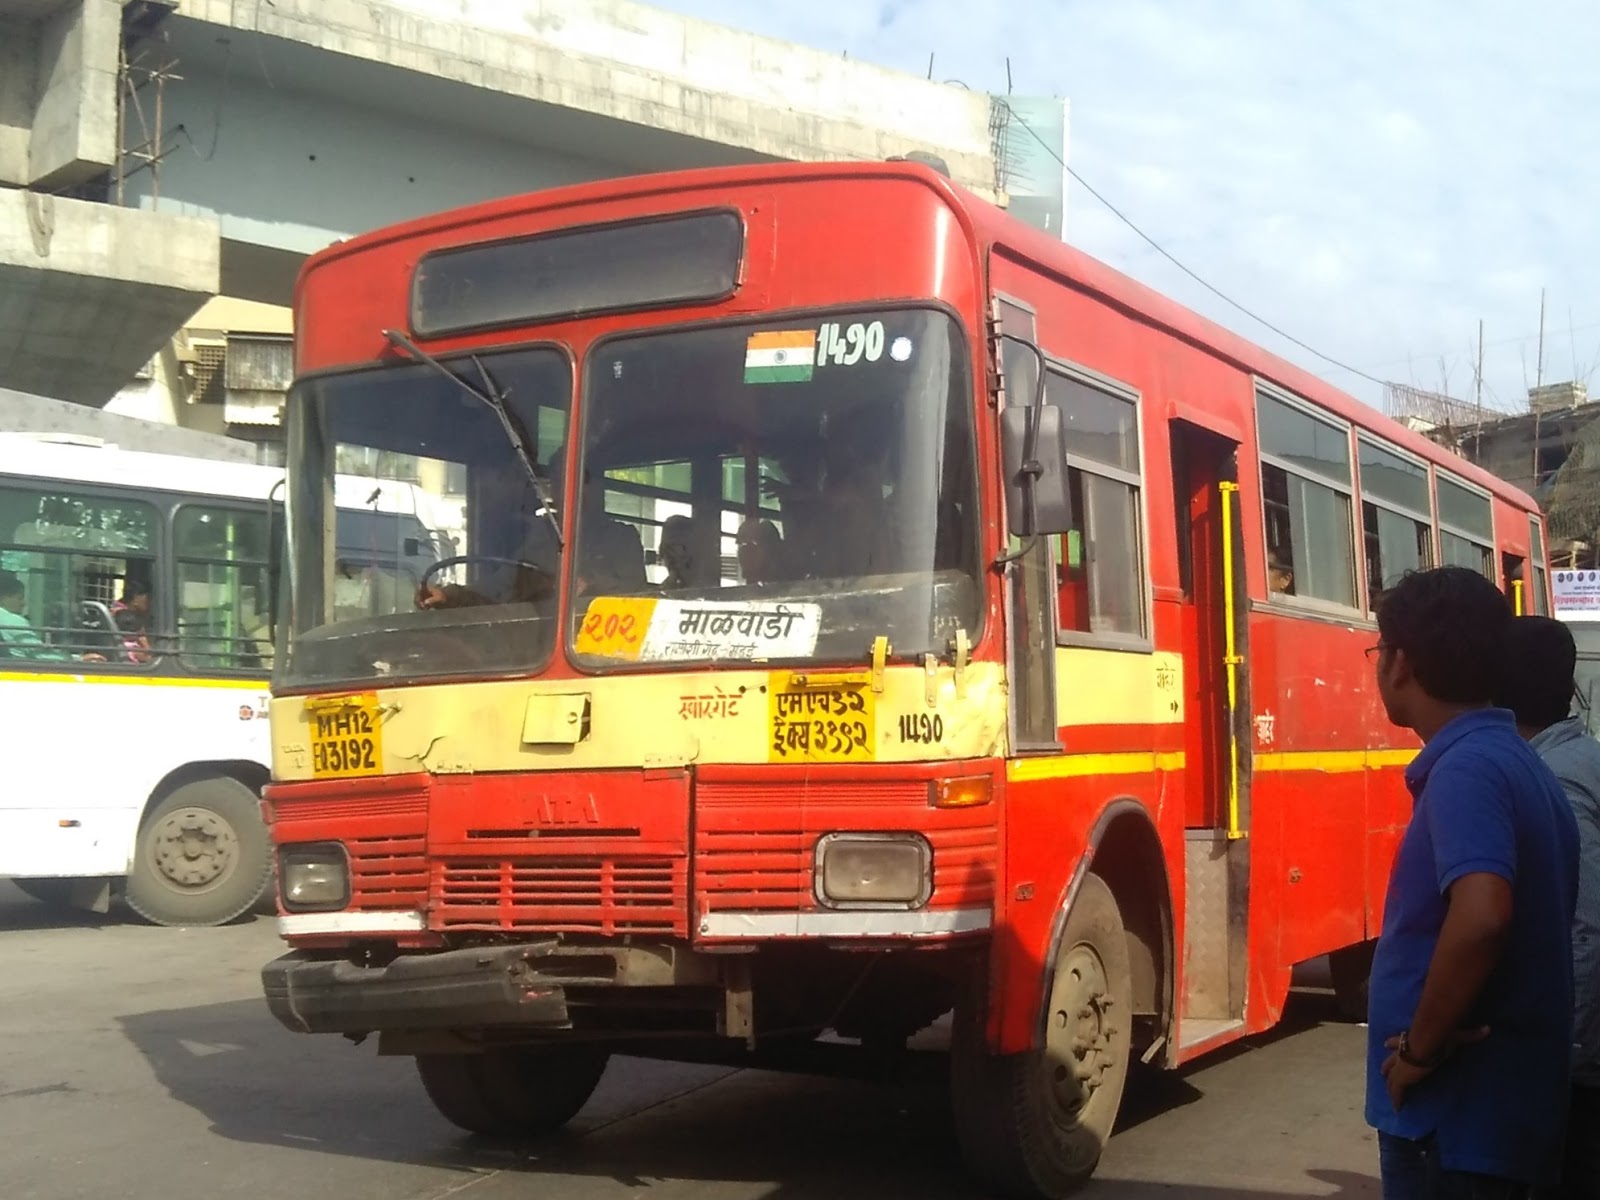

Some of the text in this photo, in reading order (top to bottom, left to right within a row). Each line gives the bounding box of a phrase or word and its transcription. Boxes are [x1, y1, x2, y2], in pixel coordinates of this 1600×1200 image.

[817, 320, 885, 366] 1490
[584, 604, 804, 642] २०२ माळवाडी
[678, 686, 743, 720] स्वारगेट
[899, 712, 943, 743] 1490
